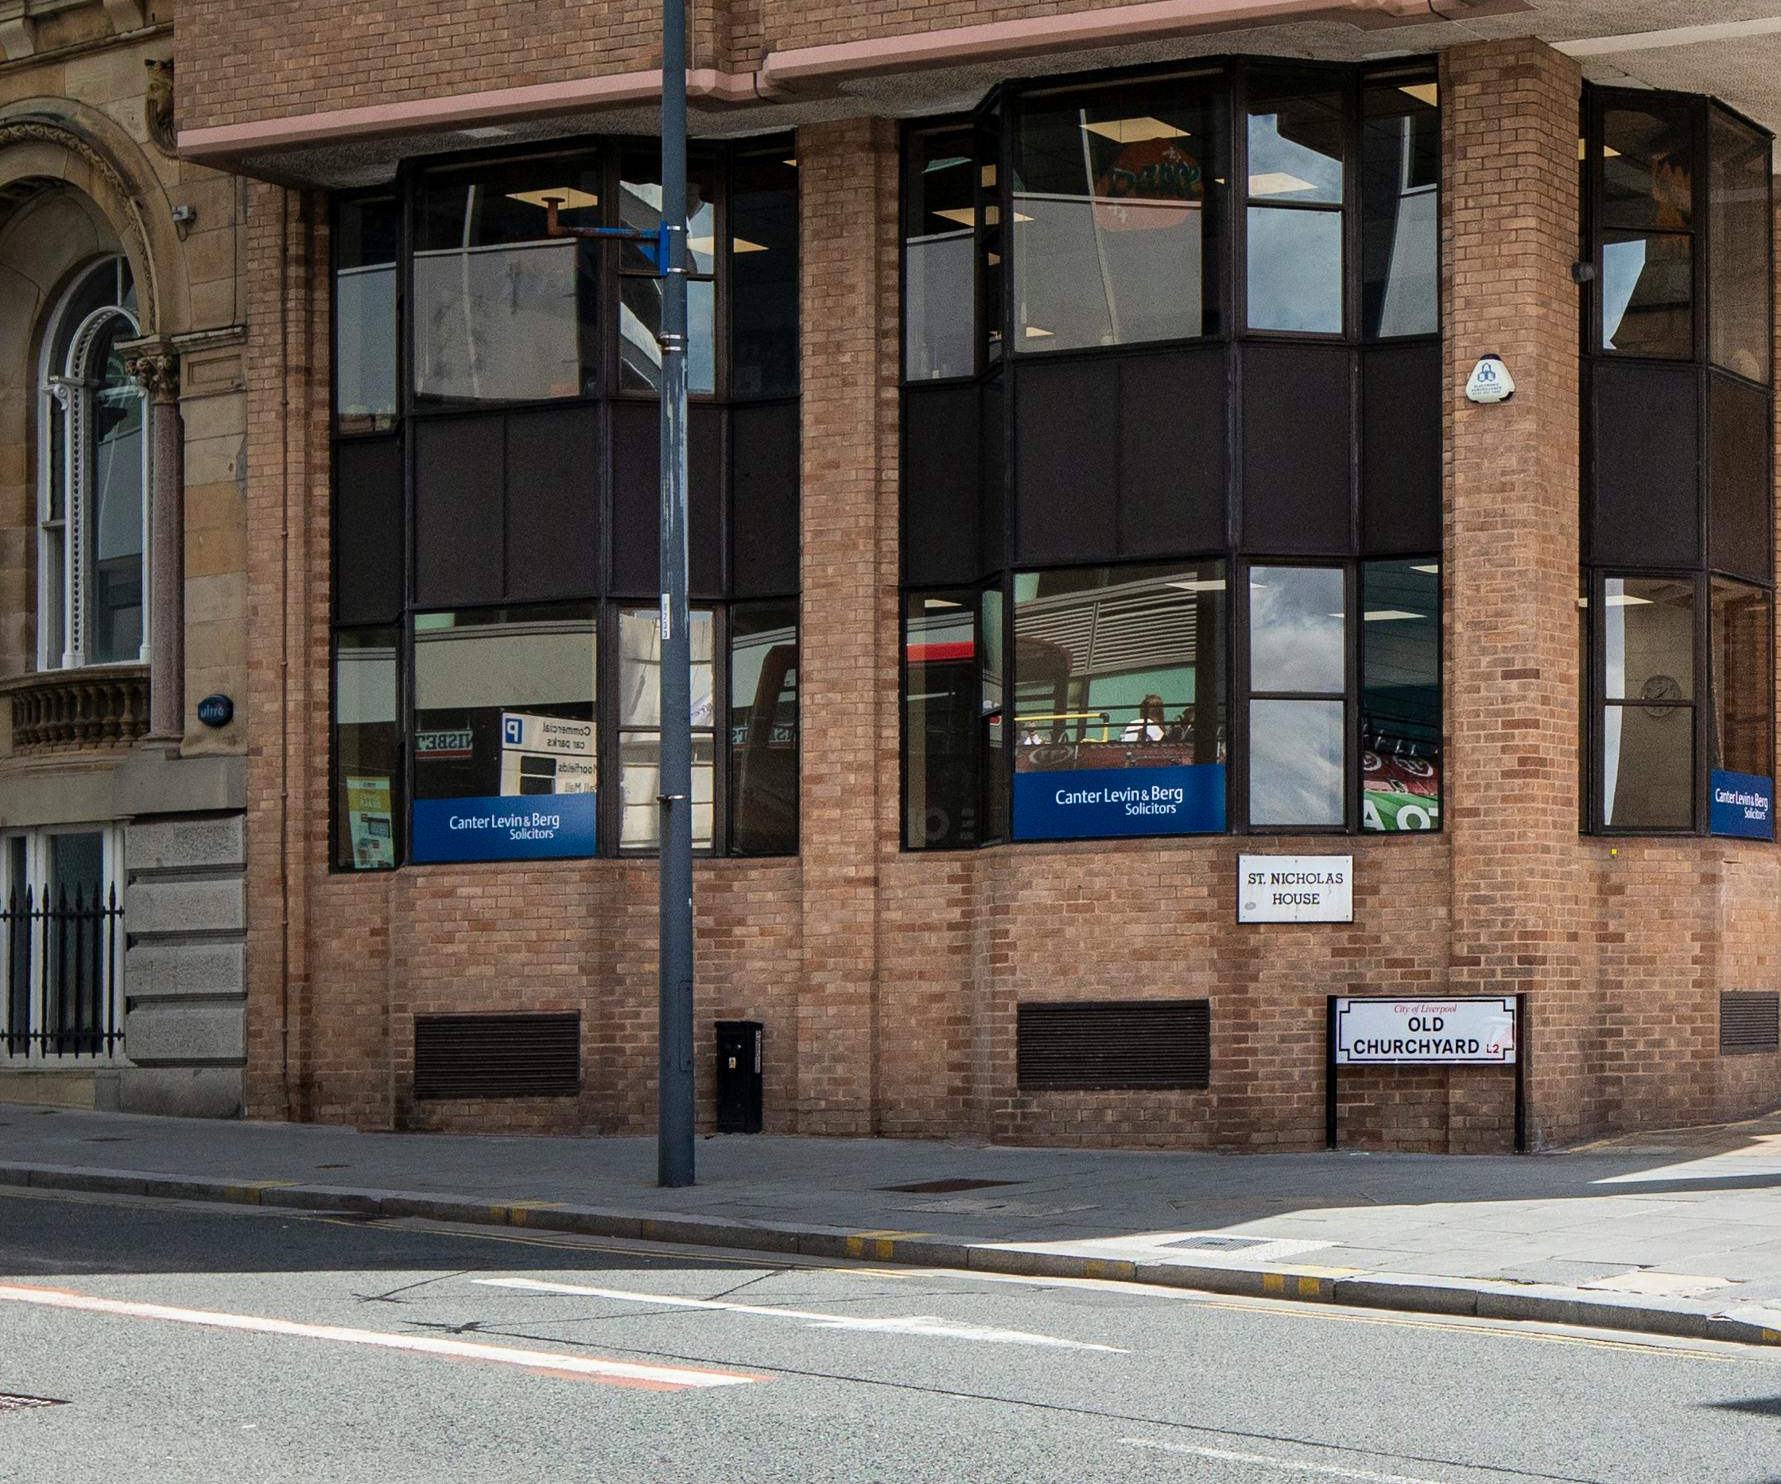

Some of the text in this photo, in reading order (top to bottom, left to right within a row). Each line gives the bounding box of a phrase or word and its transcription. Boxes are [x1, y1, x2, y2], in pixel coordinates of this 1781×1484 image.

[1055, 785, 1184, 806] Canter Levin & Berg
[1715, 787, 1736, 804] Canter
[1735, 790, 1751, 806] Levin
[1754, 792, 1769, 812] Berg
[1125, 802, 1177, 816] Solicitors
[1744, 806, 1766, 821] Solicitors
[449, 812, 560, 830] Canter Levin & Berg
[509, 828, 554, 840] Solicitors
[1247, 872, 1344, 885] ST. NICHOLAS
[1272, 893, 1320, 905] HOUSE
[1393, 1003, 1458, 1015] City of Liverpool
[1407, 1016, 1445, 1033] OLD
[1353, 1038, 1500, 1055] CHURCHYARD L2
